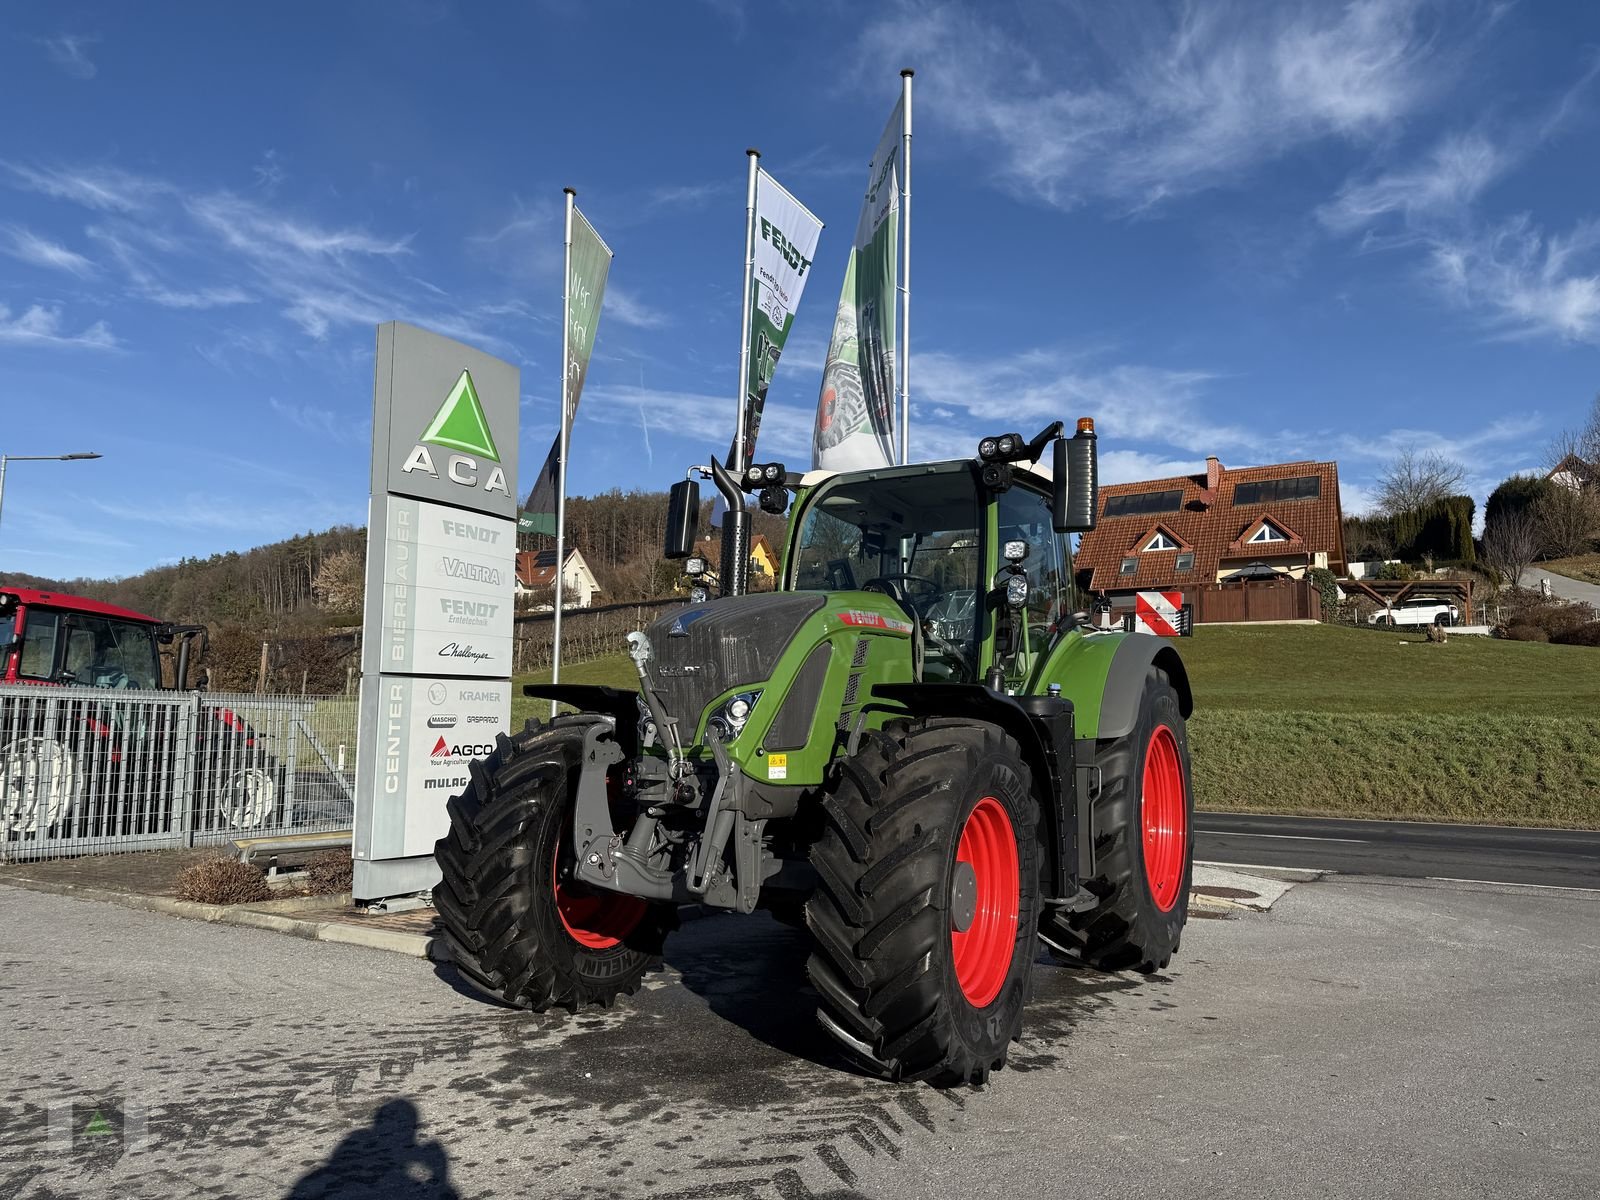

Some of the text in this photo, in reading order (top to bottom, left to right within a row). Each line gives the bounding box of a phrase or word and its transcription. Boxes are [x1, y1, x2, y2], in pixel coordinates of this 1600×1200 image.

[760, 216, 812, 277] FENDT
[401, 445, 511, 498] ACA
[442, 519, 501, 544] FENDT
[442, 556, 501, 585] VALTRA
[391, 509, 411, 661] BIERBAUER
[440, 598, 499, 618] FENDT
[849, 609, 880, 625] FENDT
[448, 614, 488, 626] Erntetechnik
[438, 642, 496, 664] Challenger
[459, 690, 501, 702] KRAMER
[466, 715, 499, 724] GASPARDO
[385, 684, 404, 794] CENTER
[451, 744, 493, 757] AGCO
[443, 759, 470, 768] Agriculture
